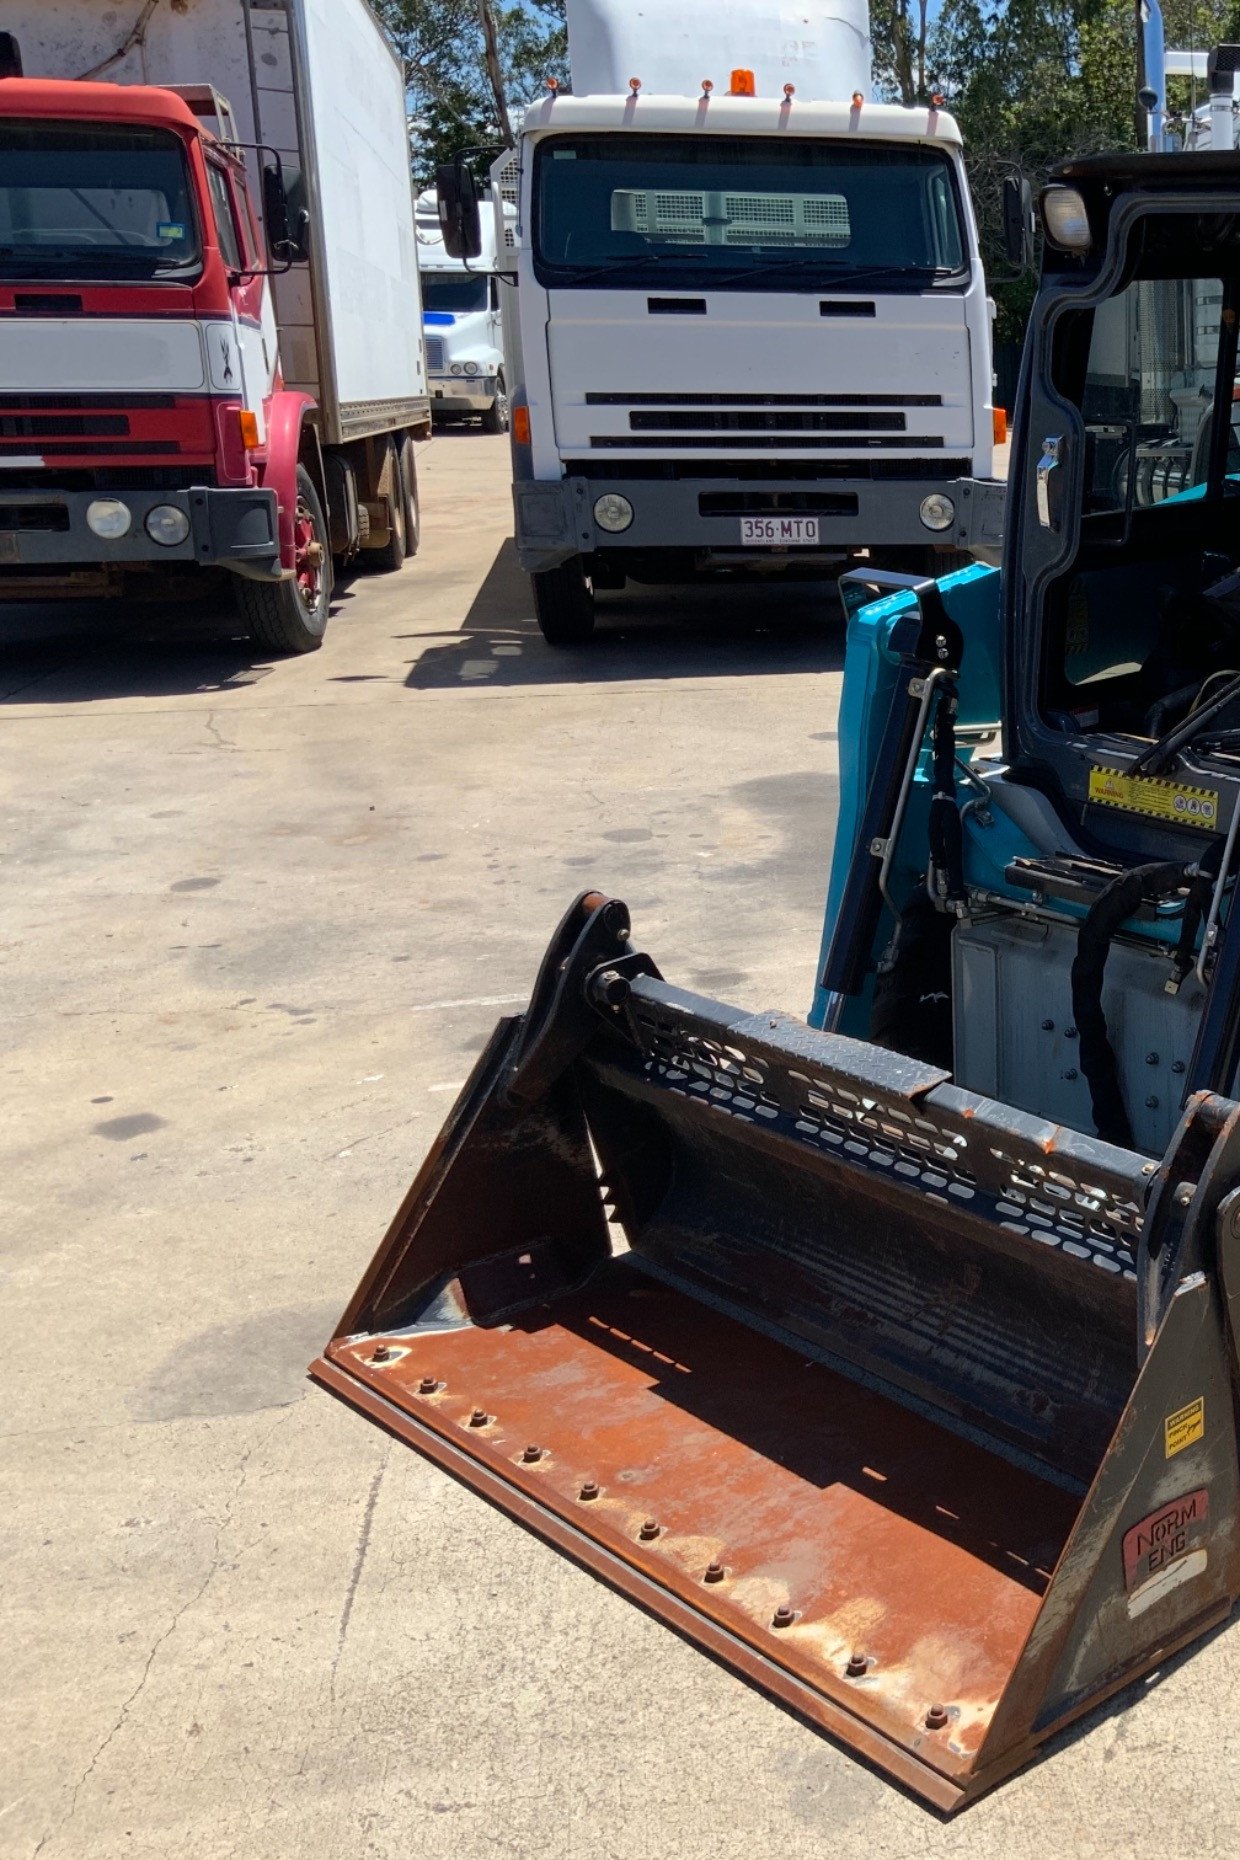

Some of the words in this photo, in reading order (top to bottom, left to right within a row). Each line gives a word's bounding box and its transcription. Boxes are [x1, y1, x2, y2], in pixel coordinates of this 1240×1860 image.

[1095, 786, 1124, 799] WARNING
[1168, 1404, 1200, 1428] WARNING
[1168, 1422, 1189, 1439] PINCH
[1168, 1435, 1188, 1451] POINT
[1137, 1498, 1198, 1556] NORM
[1149, 1530, 1186, 1572] ENG
